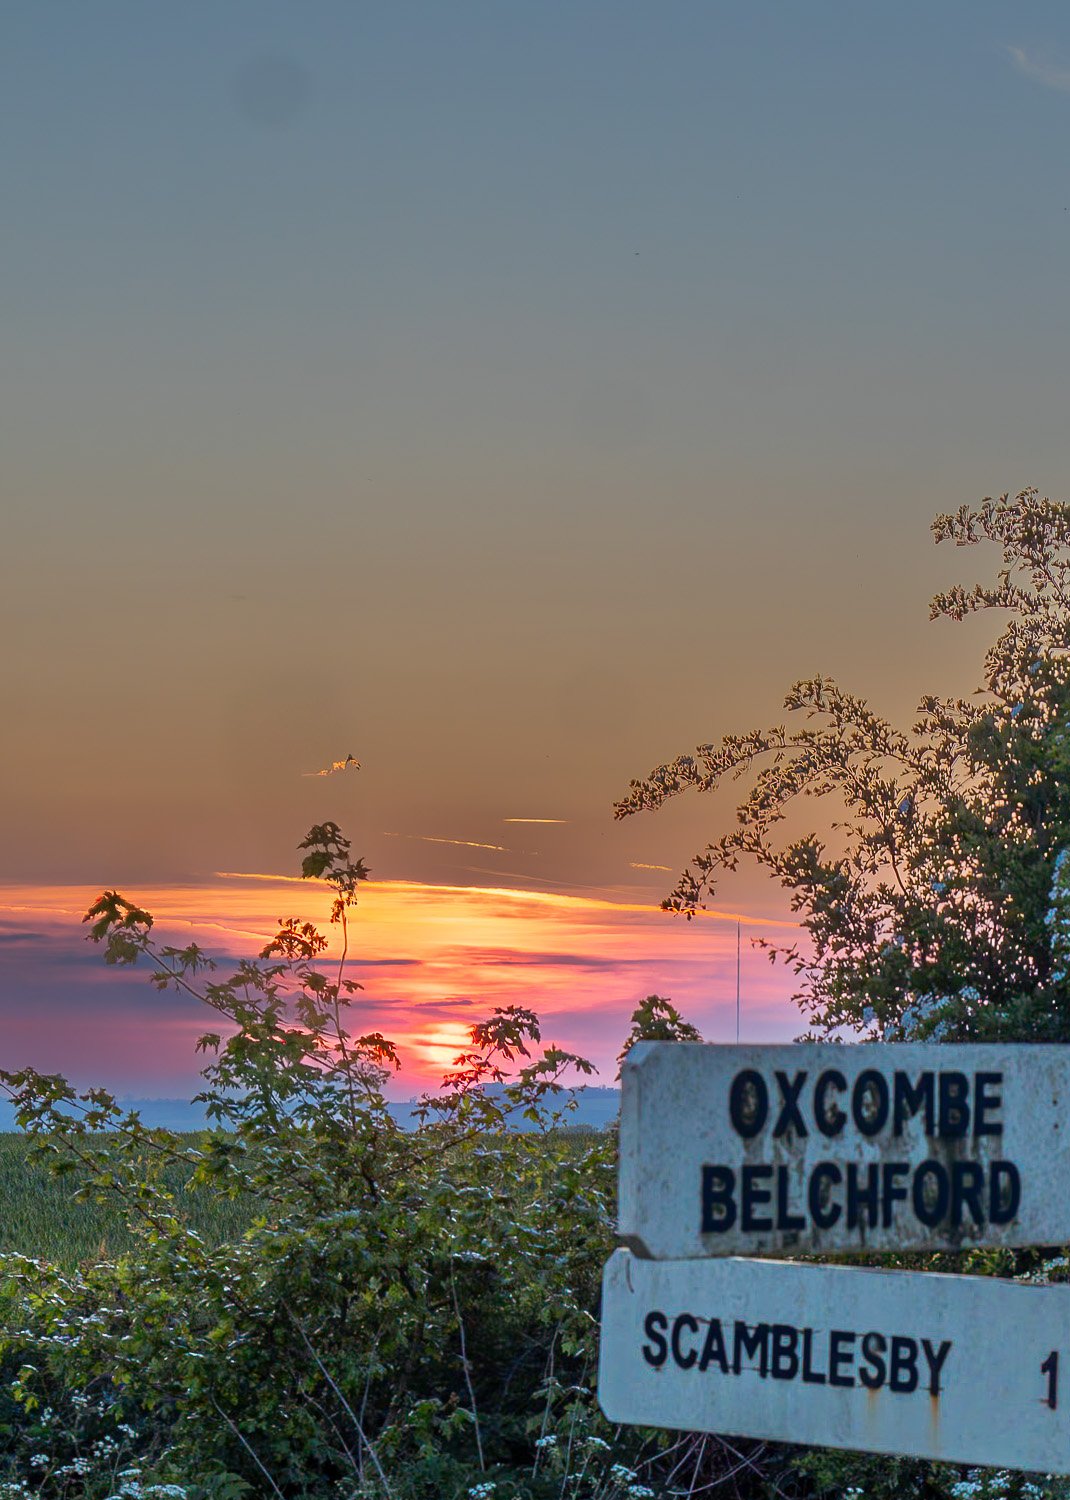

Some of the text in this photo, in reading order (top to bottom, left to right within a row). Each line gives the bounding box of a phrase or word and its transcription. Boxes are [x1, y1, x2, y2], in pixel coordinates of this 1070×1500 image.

[729, 1069, 1004, 1138] OXCOMBE
[701, 1160, 1021, 1233] BELCHFORD
[642, 1310, 1060, 1410] SCAMBLESBY 1
